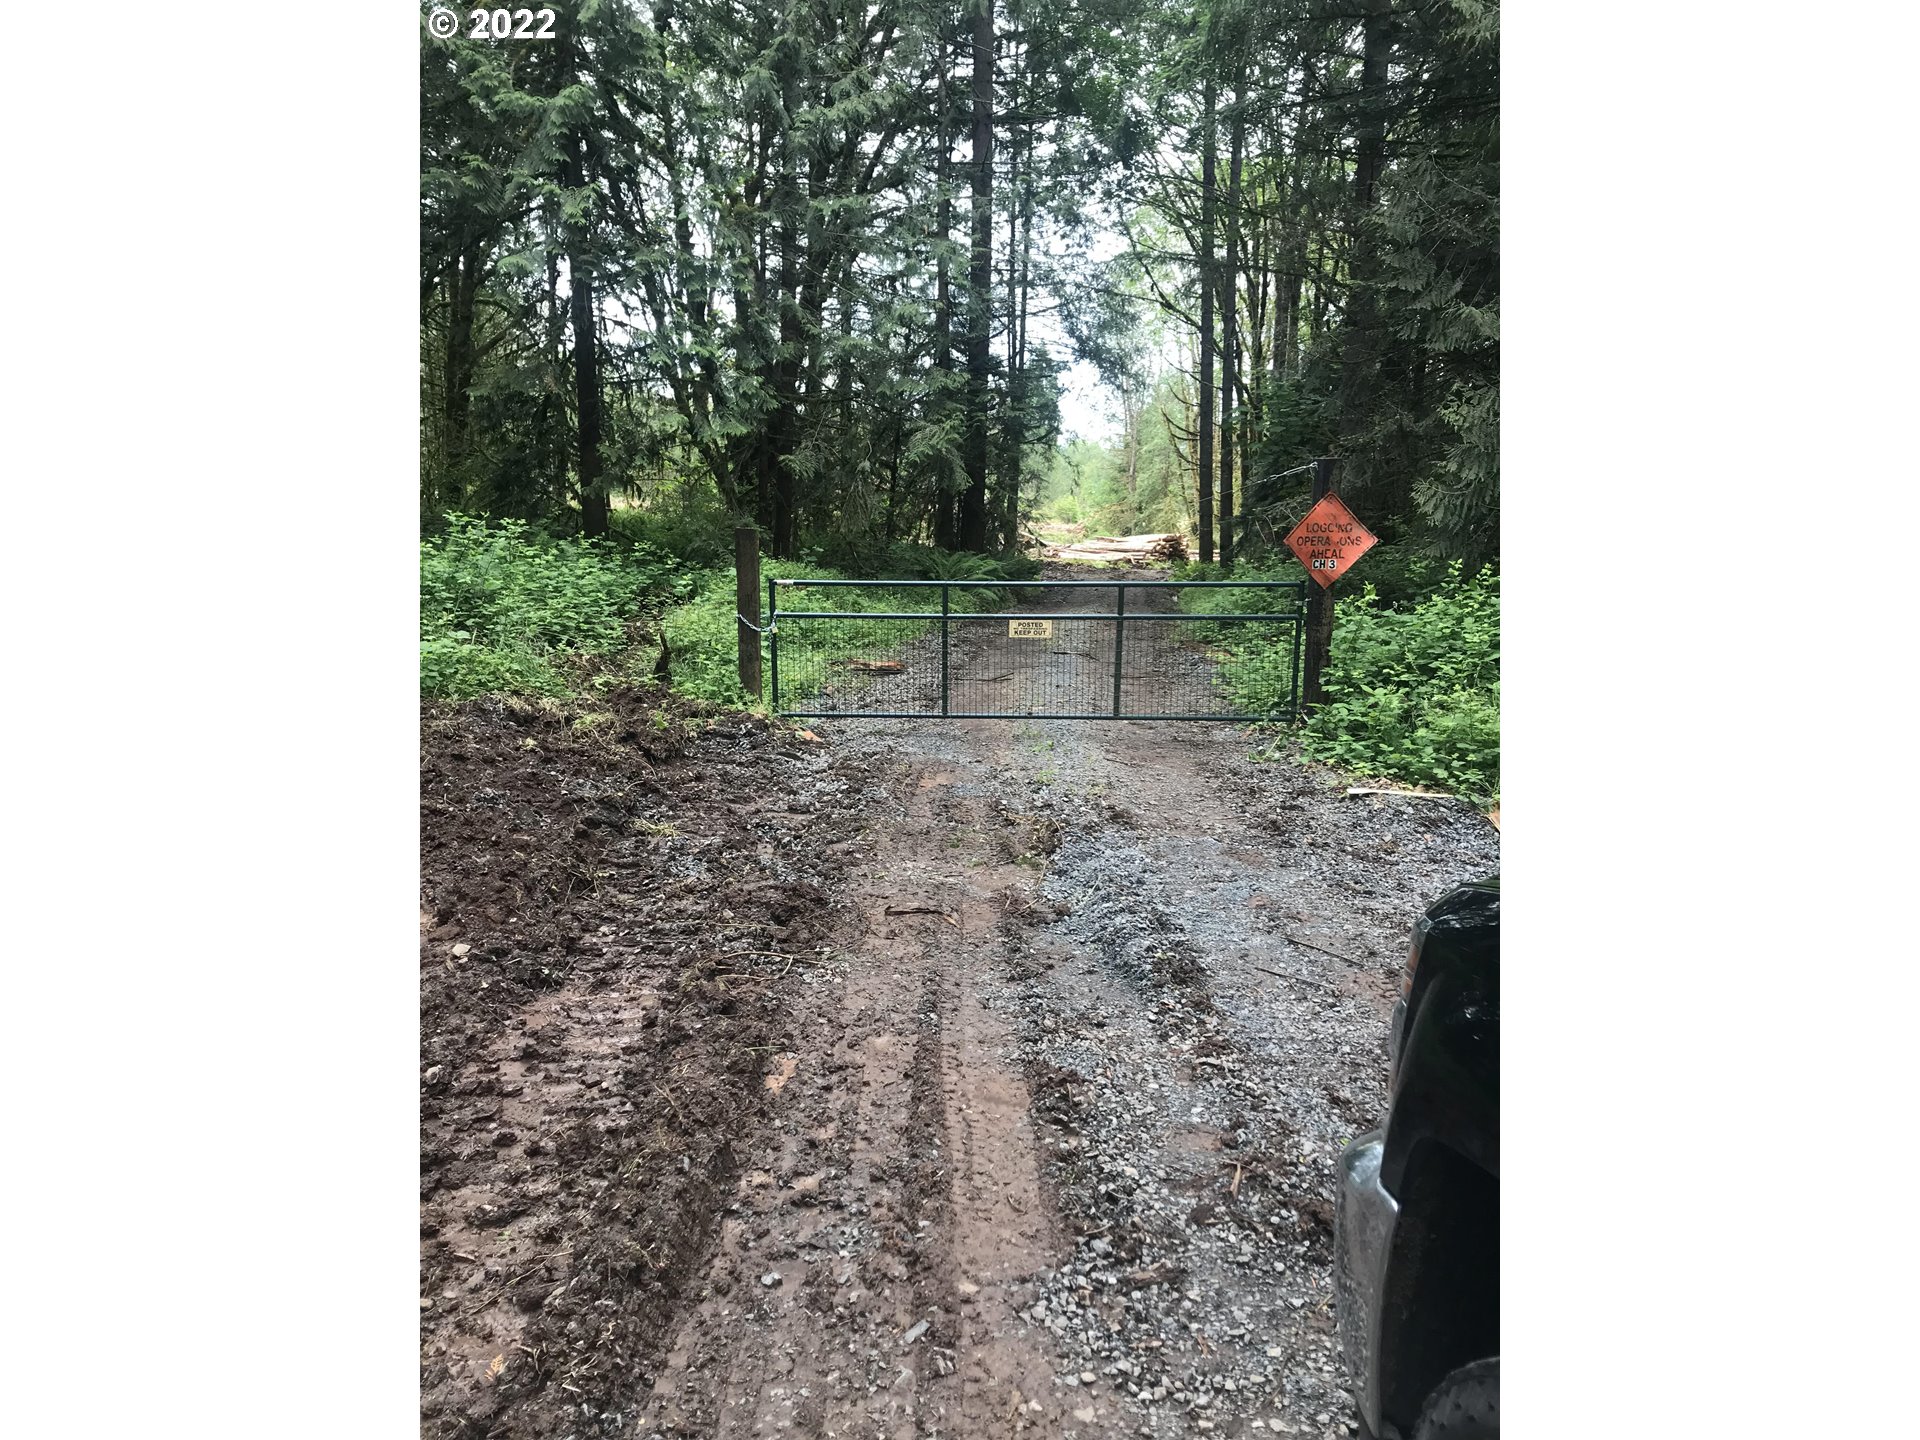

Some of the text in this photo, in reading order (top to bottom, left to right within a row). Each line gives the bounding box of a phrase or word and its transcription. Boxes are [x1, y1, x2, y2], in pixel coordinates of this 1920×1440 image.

[1297, 536, 1362, 546] OPERAONS
[1312, 559, 1336, 569] CH 3
